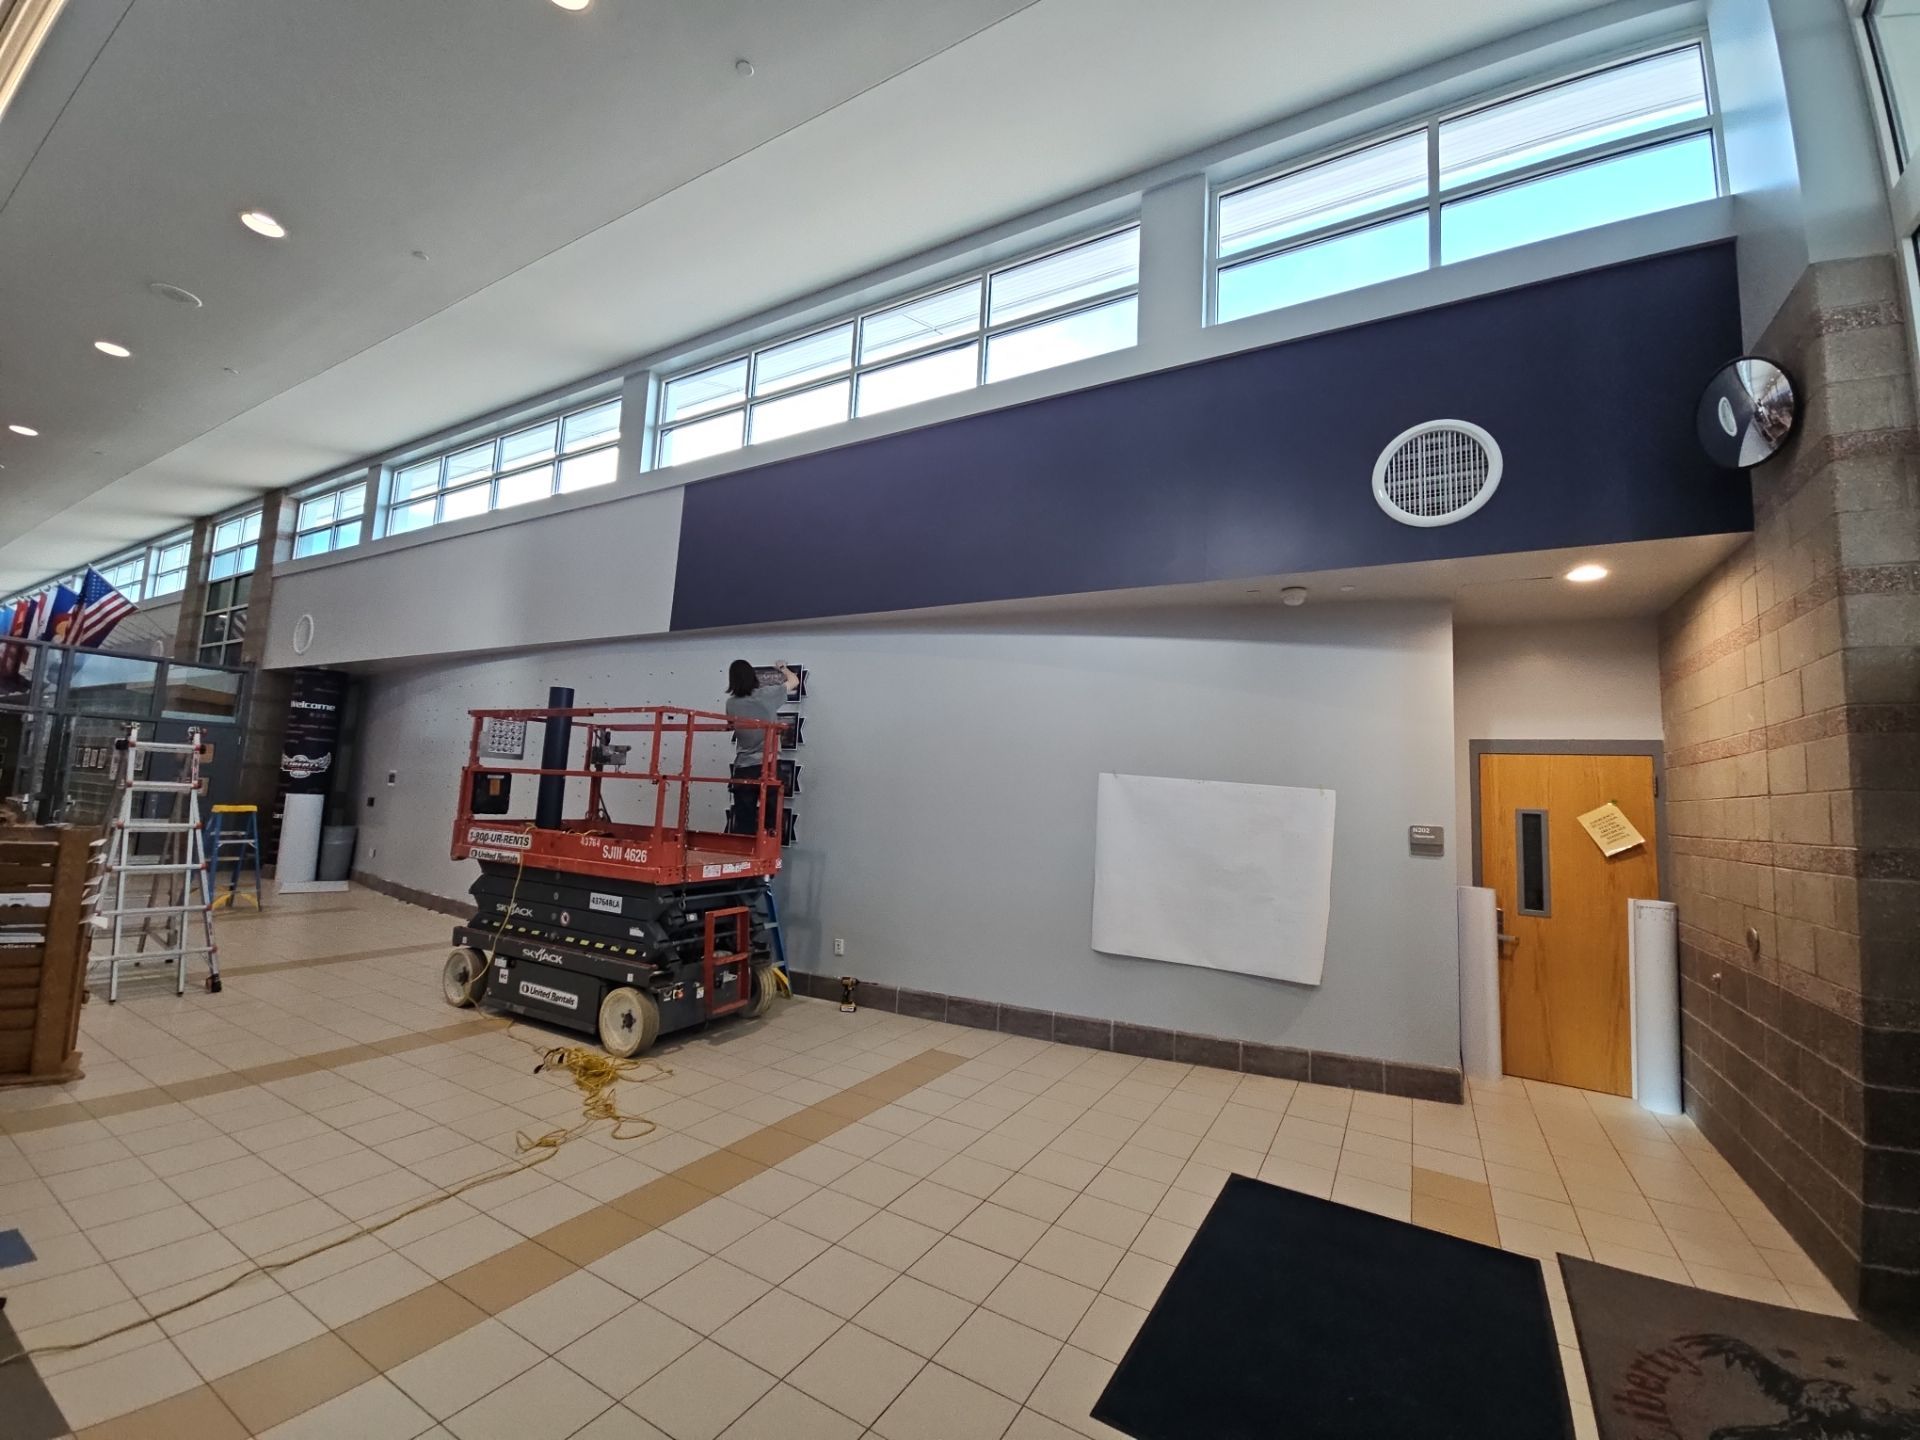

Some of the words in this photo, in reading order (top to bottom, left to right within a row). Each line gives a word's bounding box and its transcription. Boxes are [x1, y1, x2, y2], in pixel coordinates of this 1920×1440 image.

[624, 848, 648, 863] 4626
[522, 948, 563, 965] SKYJACK
[530, 986, 551, 999] United
[551, 992, 575, 1006] Rentals
